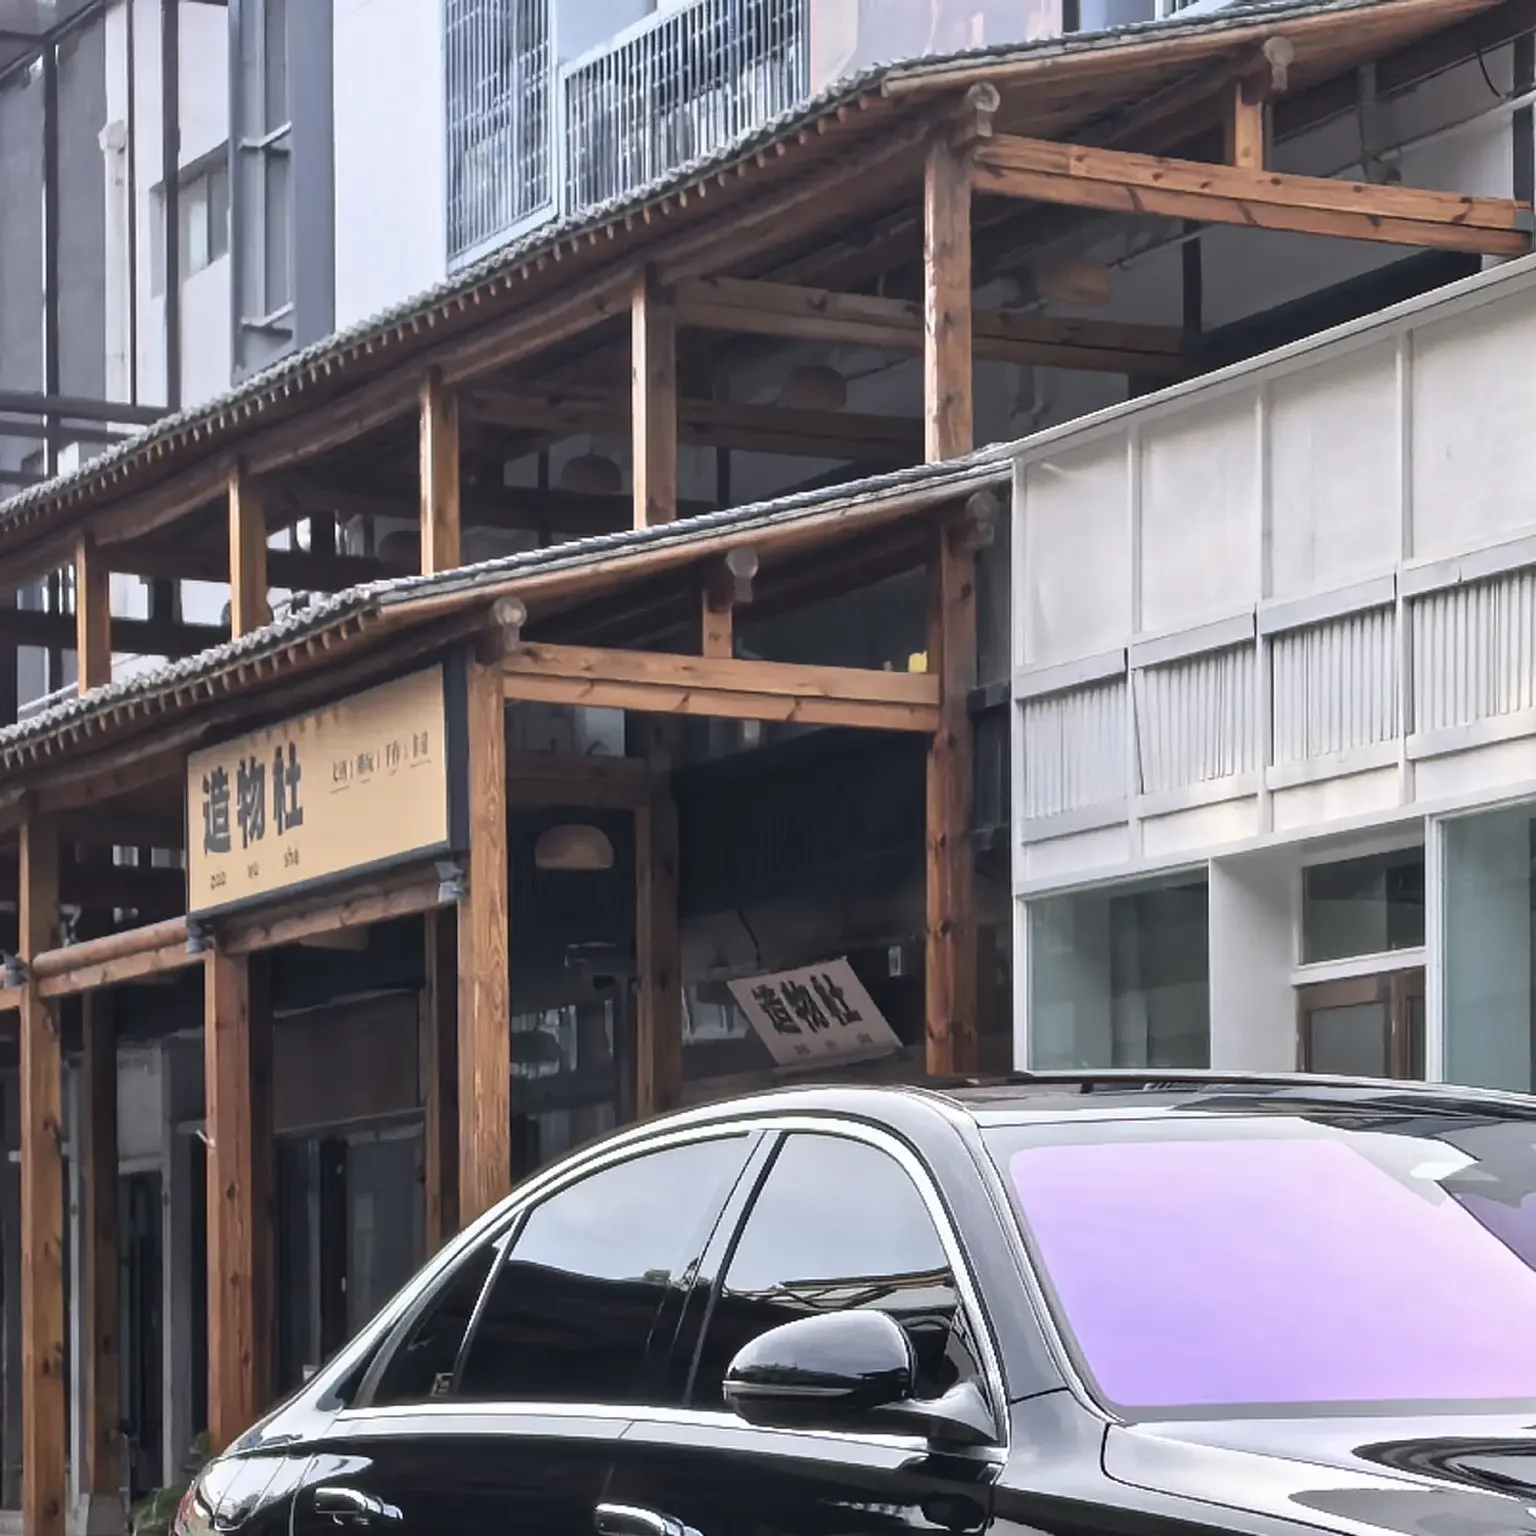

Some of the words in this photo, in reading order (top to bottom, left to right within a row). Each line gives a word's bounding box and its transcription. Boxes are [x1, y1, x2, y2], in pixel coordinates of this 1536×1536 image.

[203, 741, 303, 858] 造物社
[751, 973, 863, 1035] 造物社
